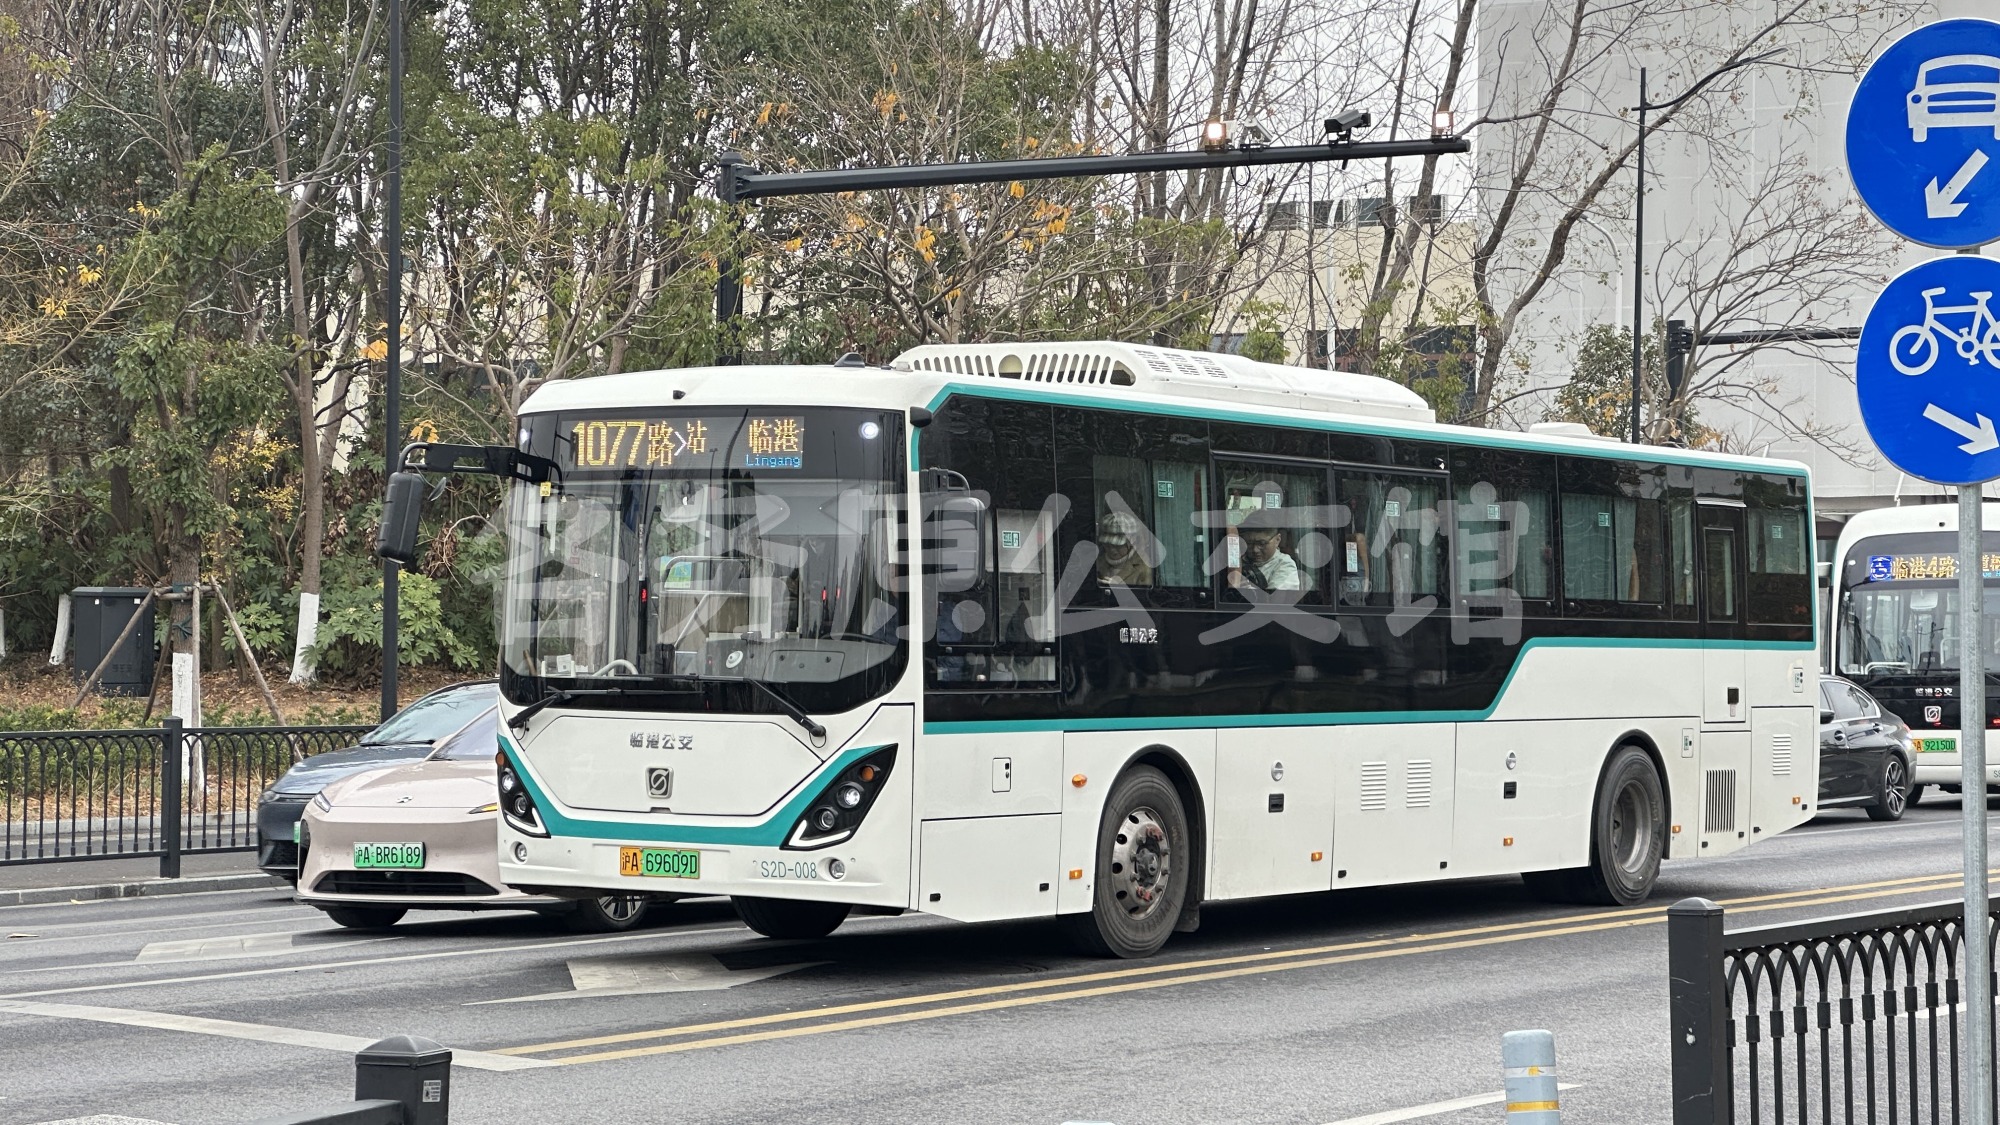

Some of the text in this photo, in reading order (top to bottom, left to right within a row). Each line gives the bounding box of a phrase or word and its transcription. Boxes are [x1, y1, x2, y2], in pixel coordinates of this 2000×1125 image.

[749, 419, 799, 453] 临港
[746, 455, 800, 467] Lingang
[1892, 556, 1956, 579] 临港4路
[629, 731, 693, 750] 临港公交
[1925, 740, 1956, 751] 92150D
[646, 853, 697, 874] 69609D
[761, 861, 818, 879] S2D-008
